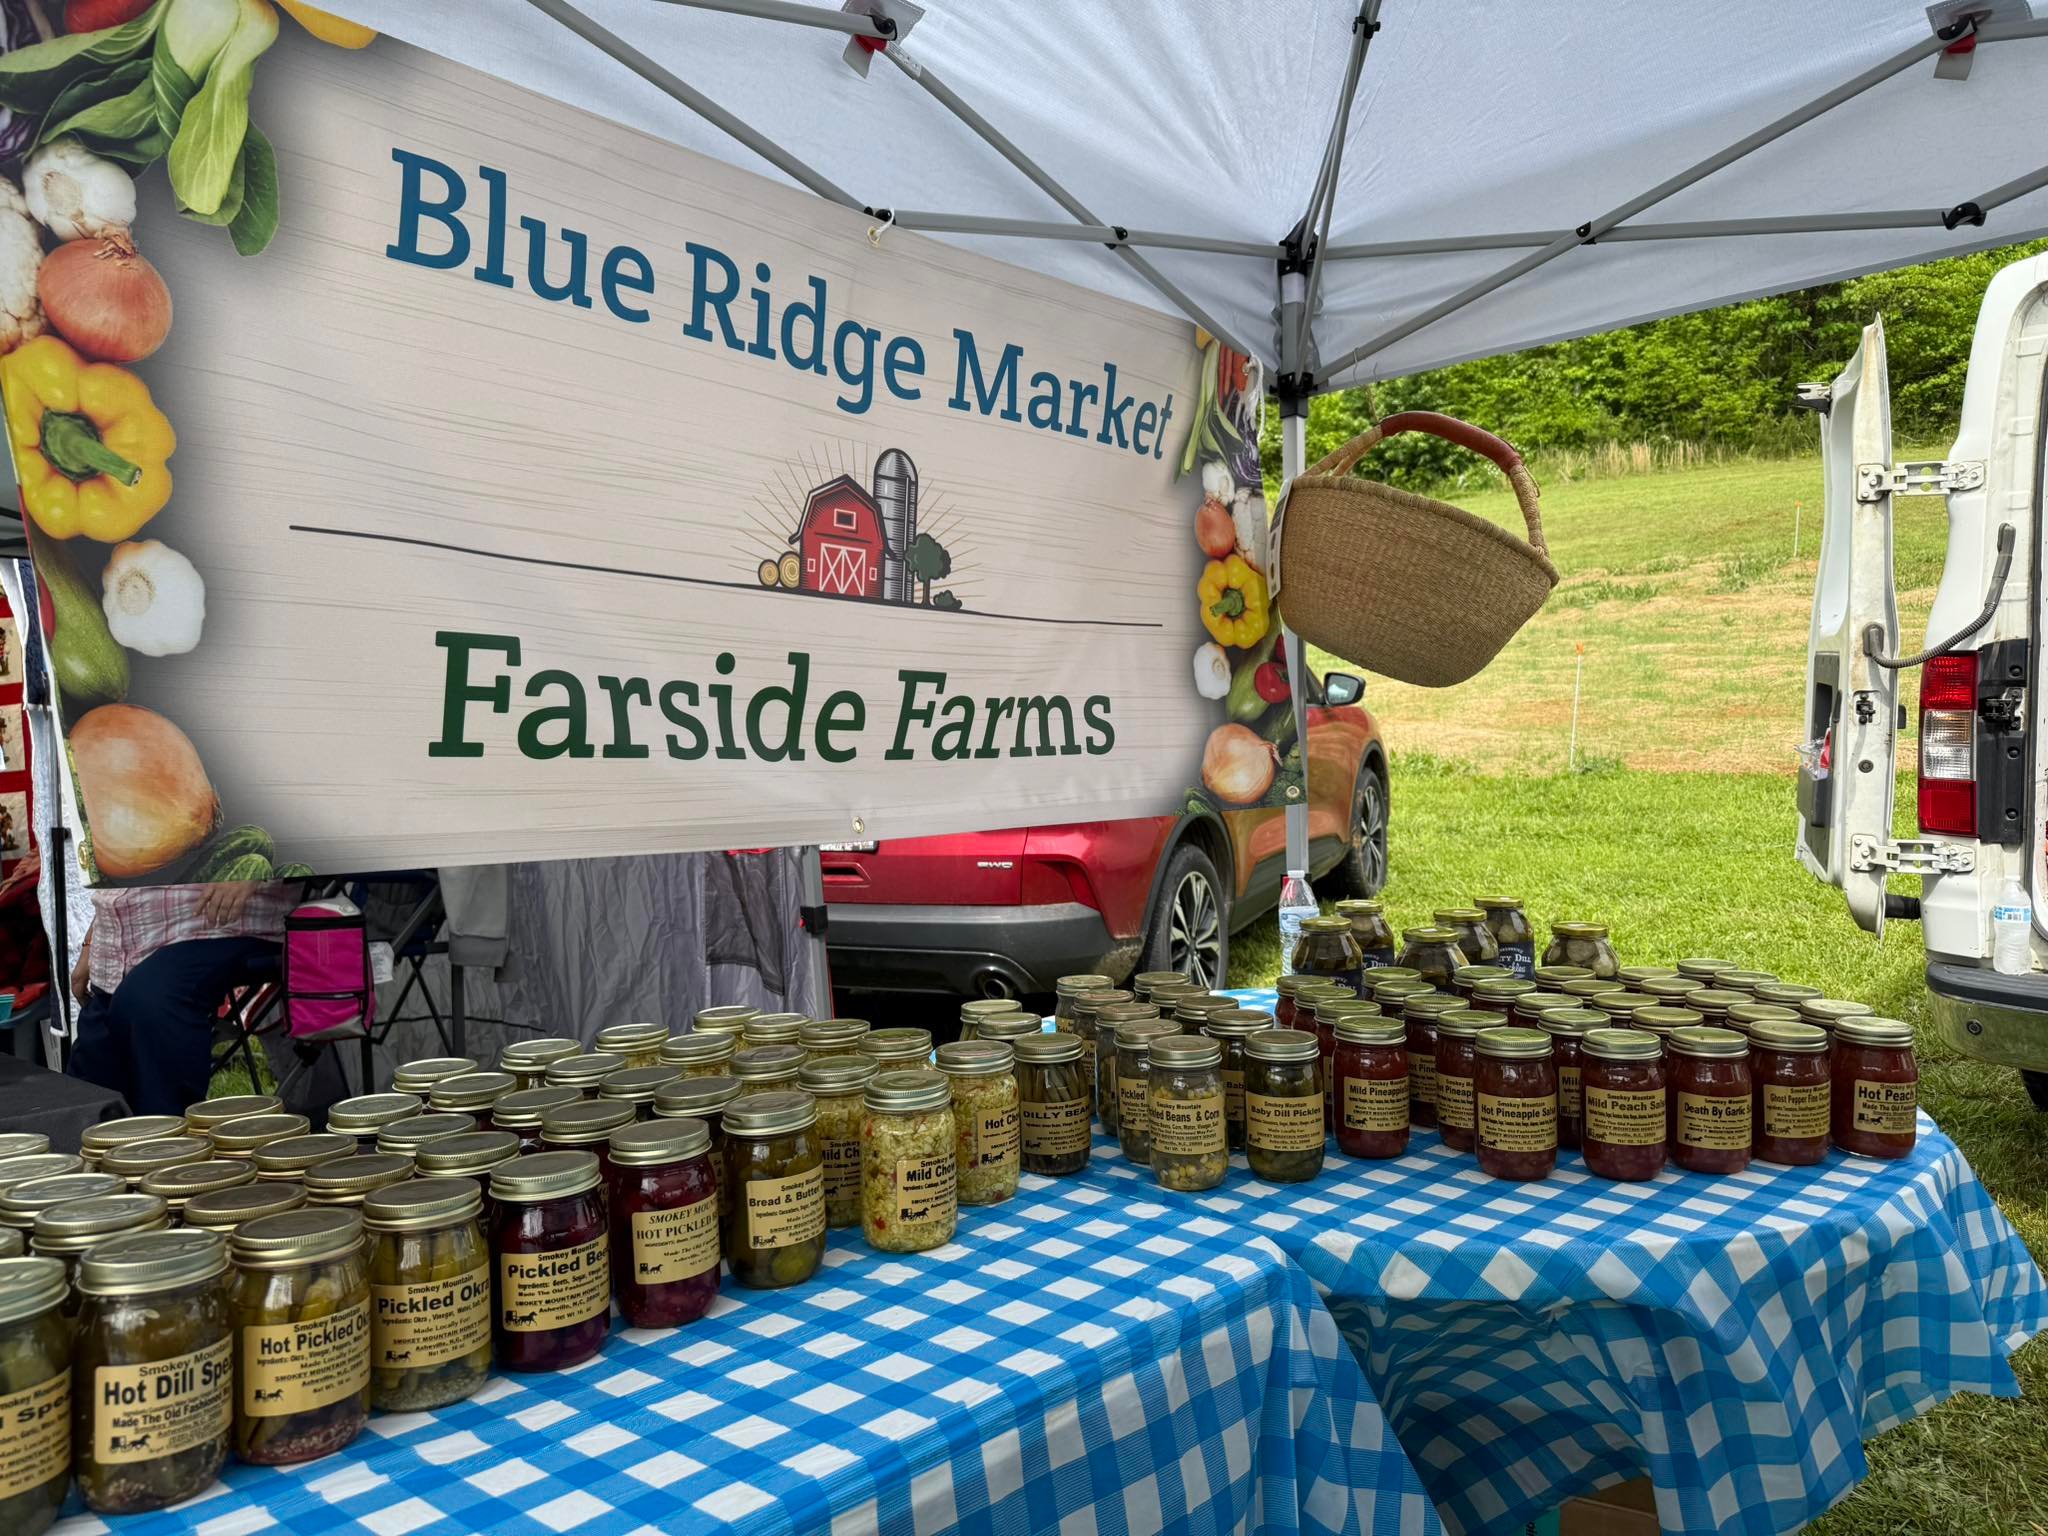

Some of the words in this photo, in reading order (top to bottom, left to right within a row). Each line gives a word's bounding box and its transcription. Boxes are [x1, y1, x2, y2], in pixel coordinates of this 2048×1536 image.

[386, 147, 655, 323] Blue
[683, 242, 925, 414] Ridge
[948, 328, 1173, 460] Market
[428, 631, 865, 762] Farside
[884, 670, 1115, 760] Farms
[1120, 1088, 1145, 1100] Pickled
[1350, 1085, 1367, 1095] Mild
[1858, 1086, 1881, 1100] Hot
[1885, 1089, 1915, 1101] Peach
[1587, 1095, 1608, 1109] Mild
[1611, 1100, 1647, 1111] Peach
[1607, 1093, 1631, 1102] Smokey
[1770, 1093, 1787, 1103] Ghost
[1156, 1101, 1175, 1110] Smokey
[1251, 1105, 1271, 1117] Baby
[1274, 1109, 1290, 1117] Dill
[1481, 1104, 1494, 1115] Hot
[1496, 1107, 1540, 1120] Pineapple
[1497, 1101, 1520, 1109] Smokey
[1684, 1102, 1709, 1115] Death
[1711, 1106, 1723, 1118] By
[1725, 1106, 1746, 1116] Garlic
[1023, 1110, 1061, 1119] DILLY
[1165, 1110, 1191, 1122] Beans
[1196, 1111, 1202, 1121] &
[984, 1119, 1004, 1130] Hot
[844, 1147, 860, 1159] Ch
[920, 1157, 947, 1168] Smokey
[906, 1168, 932, 1181] Mild
[749, 1196, 781, 1207] Bread
[785, 1194, 792, 1203] &
[796, 1185, 820, 1200] Butter
[649, 1208, 692, 1225] SMOKEY
[636, 1228, 662, 1240] HOT
[665, 1215, 712, 1238] PICKLED
[537, 1250, 569, 1262] Smokey
[508, 1256, 580, 1279] Pickled
[408, 1284, 440, 1295] Smokey
[442, 1274, 474, 1289] Mountain
[378, 1290, 454, 1314] Pickled
[545, 1293, 581, 1305] MOUNTAIN
[294, 1320, 328, 1334] Smokey
[413, 1327, 433, 1335] Made
[435, 1321, 458, 1332] Locally
[261, 1337, 291, 1355] Hot
[297, 1322, 353, 1351] Pickled
[393, 1337, 421, 1345] SMOKEY
[422, 1330, 458, 1342] MOUNTAIN
[140, 1359, 190, 1377] Smokey
[275, 1371, 307, 1382] SMOKEY
[104, 1380, 147, 1406] Hot
[156, 1367, 194, 1400] Dill
[112, 1417, 139, 1429] Made
[142, 1414, 162, 1424] The
[164, 1407, 181, 1420] Old
